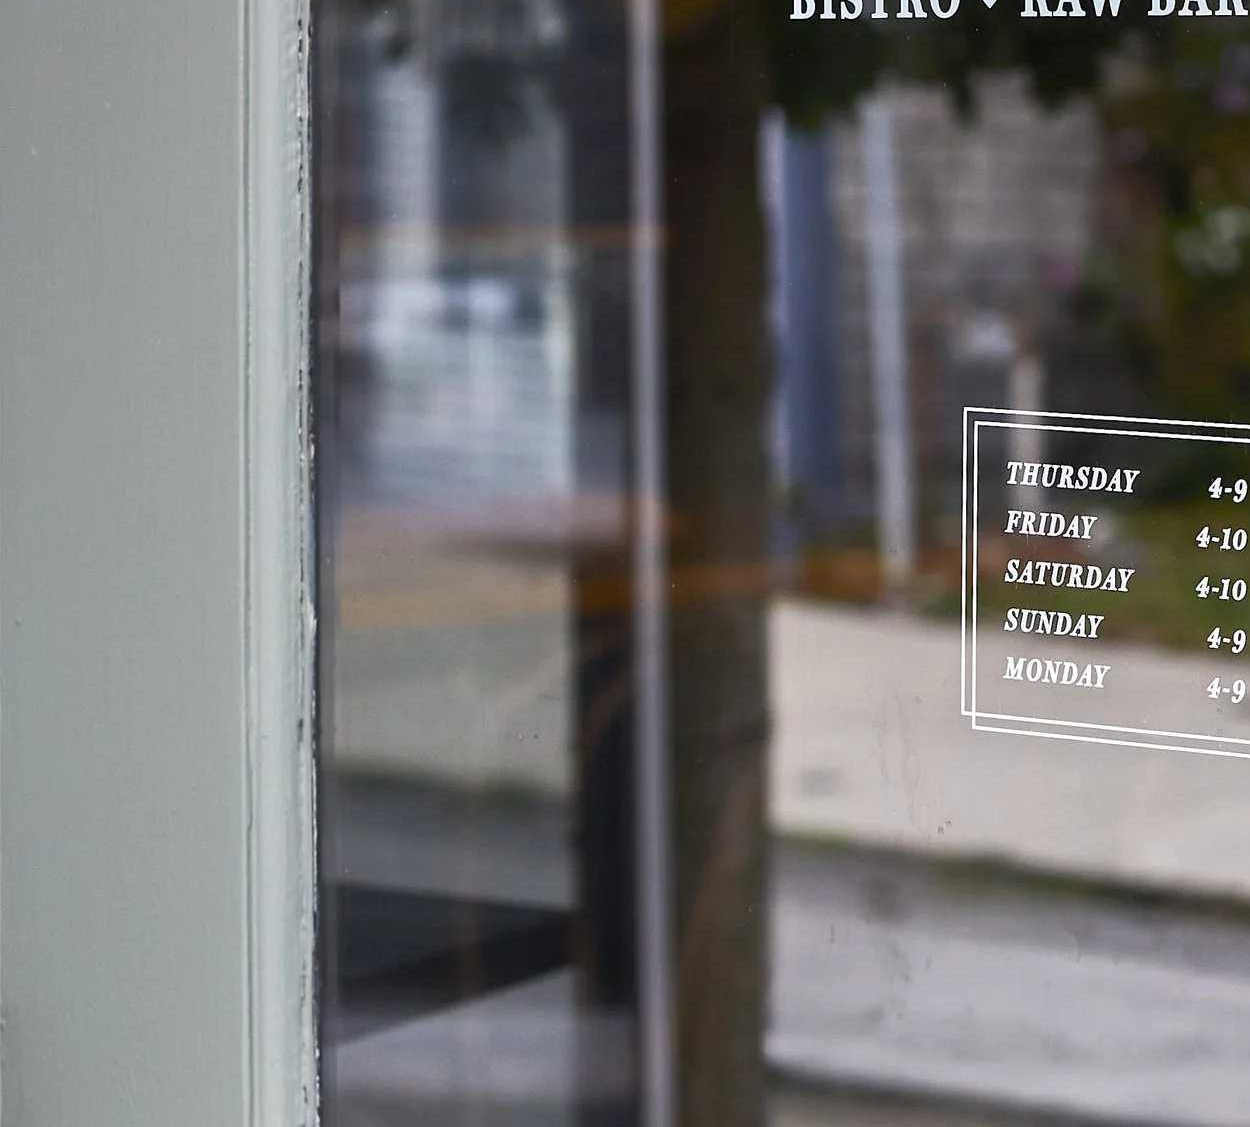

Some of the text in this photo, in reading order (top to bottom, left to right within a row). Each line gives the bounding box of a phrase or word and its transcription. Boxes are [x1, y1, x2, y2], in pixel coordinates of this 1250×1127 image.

[1006, 461, 1248, 503] THURSDAY 4-9
[1004, 510, 1247, 551] FRIDAY 4-10
[1004, 559, 1247, 601] SATURDAY 4-10
[1003, 608, 1246, 654] SUNDAY 4-9
[1002, 656, 1246, 704] MONDAY 4-9
